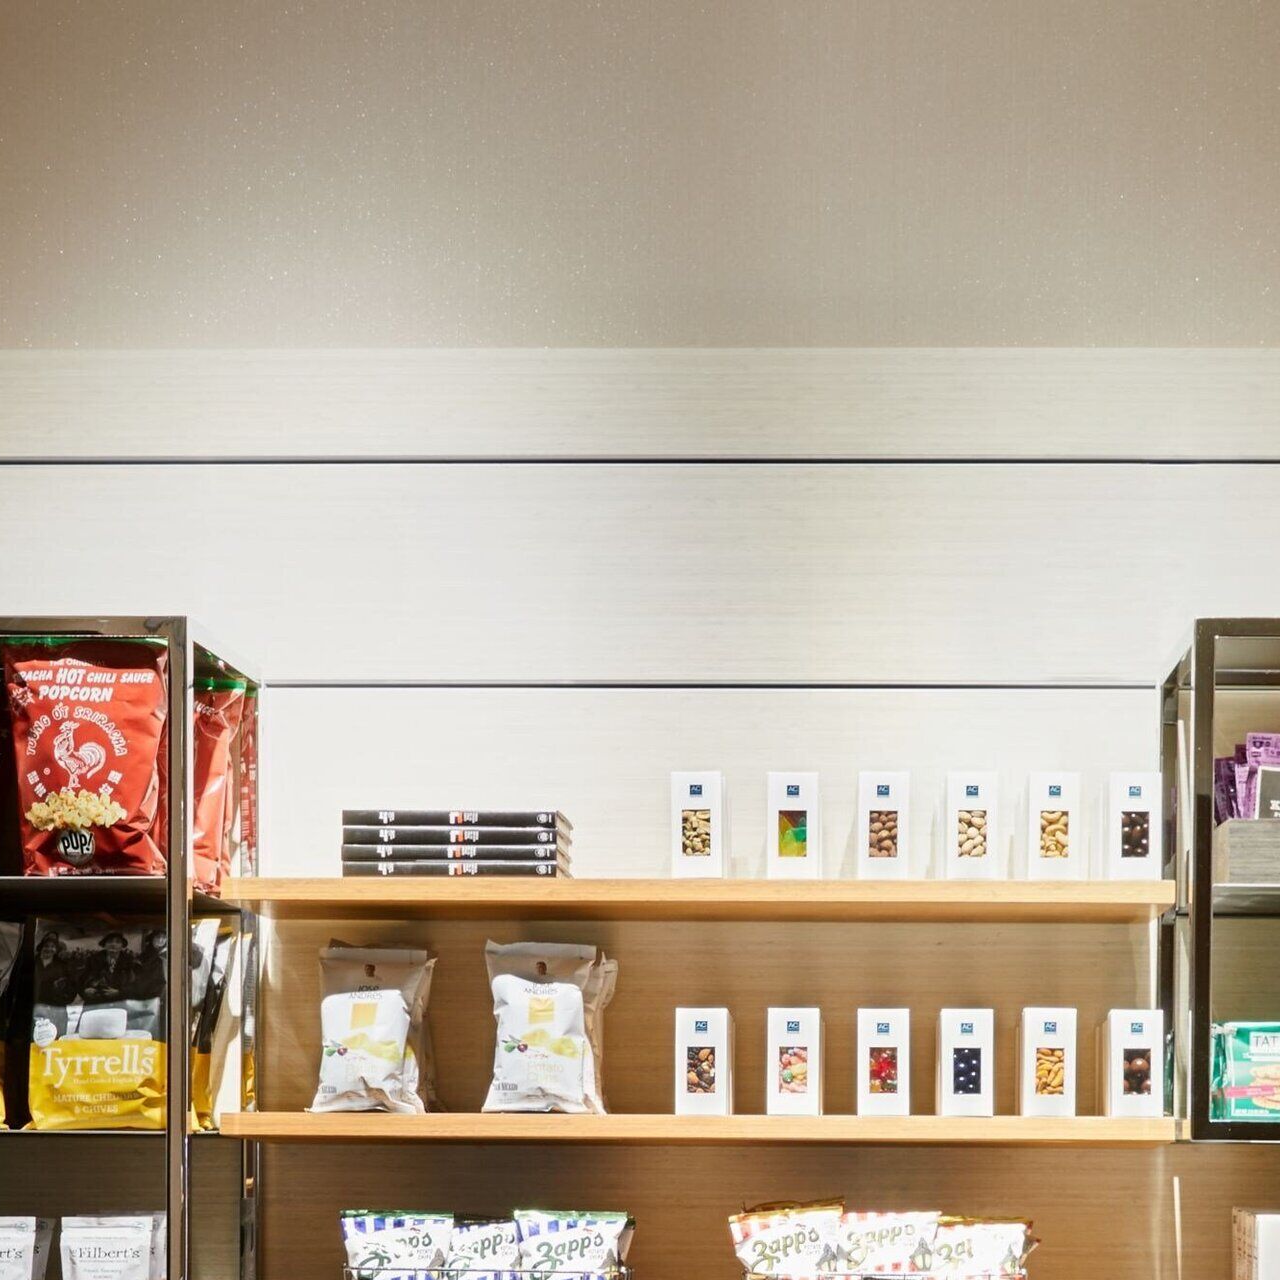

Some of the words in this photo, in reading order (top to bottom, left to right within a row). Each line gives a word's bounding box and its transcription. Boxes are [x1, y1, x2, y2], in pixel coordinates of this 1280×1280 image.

[56, 668, 85, 684] HOT
[87, 672, 116, 683] CHILI
[121, 672, 154, 684] SAUCE
[38, 685, 114, 702] POPCORN
[73, 706, 128, 757] SRIRACHA
[82, 1105, 119, 1114] CHIVES
[77, 1247, 141, 1259] Filbert's
